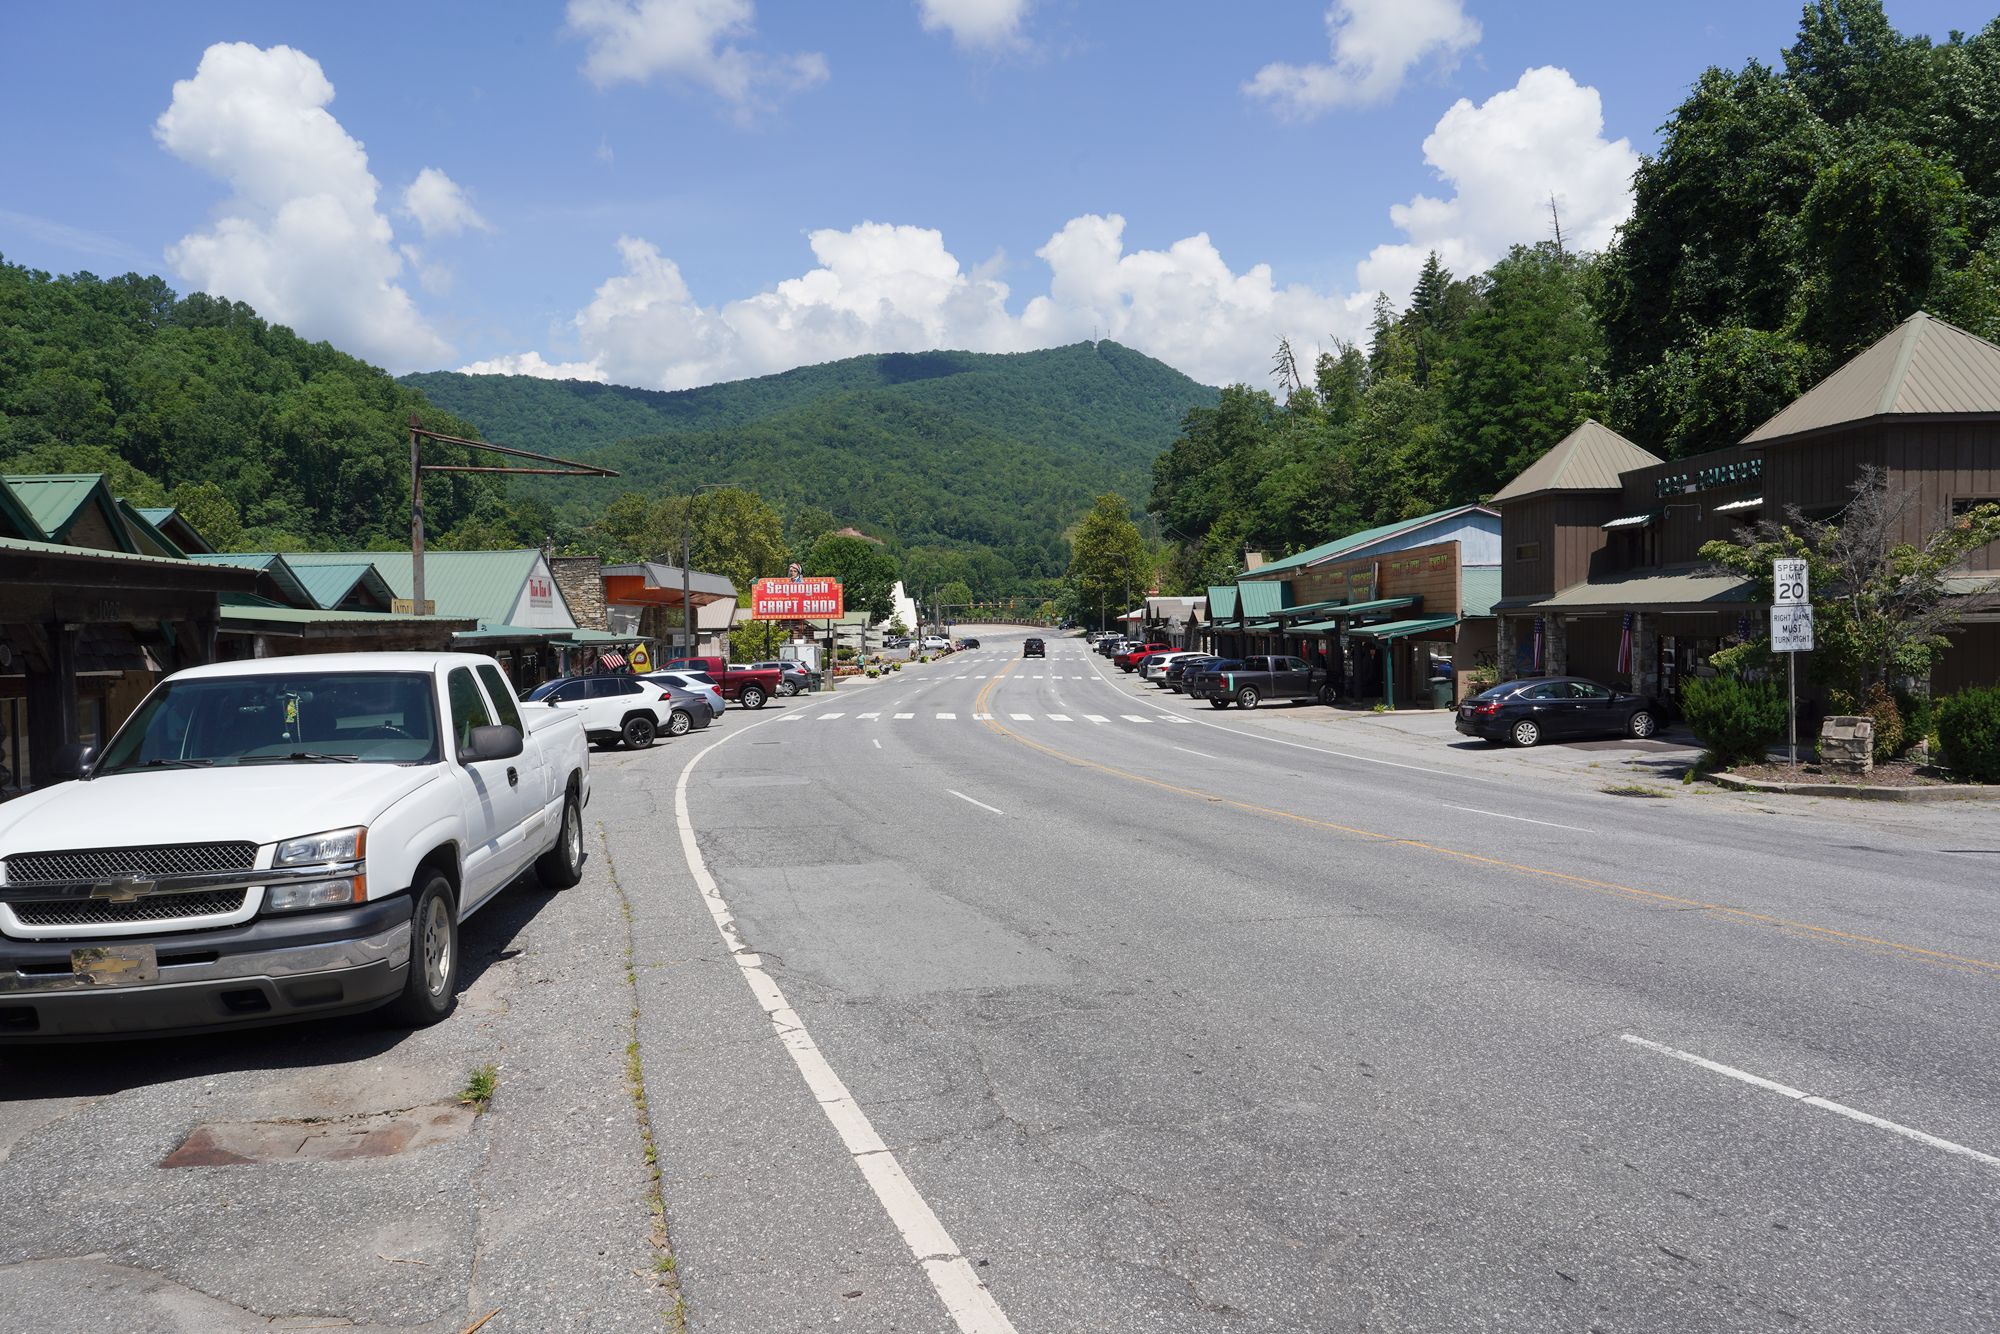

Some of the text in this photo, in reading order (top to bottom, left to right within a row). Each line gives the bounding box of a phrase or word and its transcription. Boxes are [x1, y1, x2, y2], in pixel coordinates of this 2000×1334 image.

[1777, 564, 1806, 572] SPEED
[1780, 573, 1803, 581] LIMIT
[766, 581, 829, 596] Sequoyah
[1779, 582, 1804, 600] 20
[759, 600, 836, 613] CRAFT SHOP
[1773, 613, 1810, 622] RIGHT LANE
[1782, 624, 1802, 634] MUST
[1774, 635, 1810, 644] TURN RIGHT
